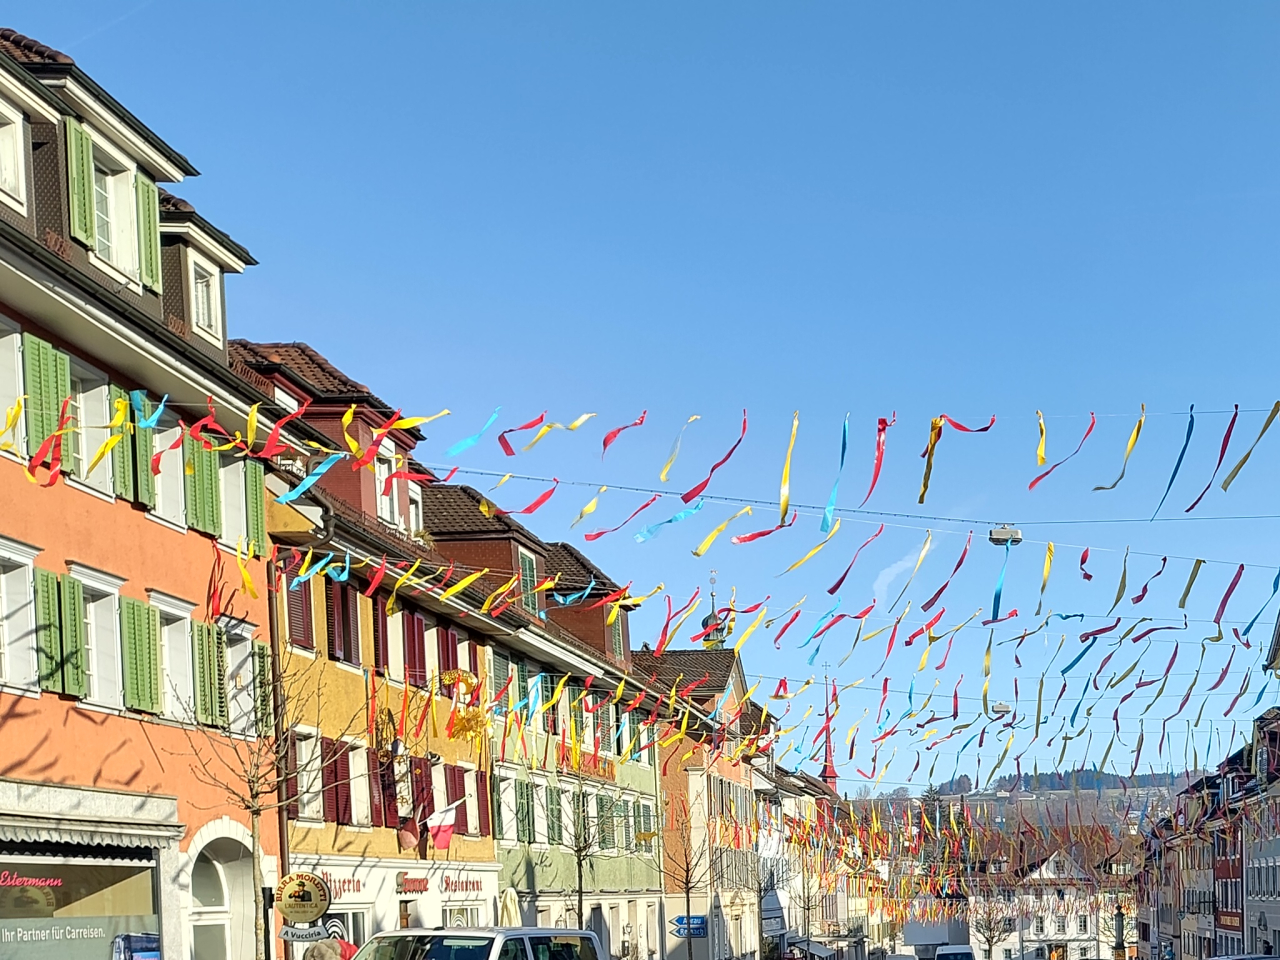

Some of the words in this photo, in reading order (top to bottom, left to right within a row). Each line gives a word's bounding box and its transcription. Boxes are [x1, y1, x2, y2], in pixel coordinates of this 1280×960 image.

[0, 871, 63, 887] Estermann
[276, 876, 295, 902] BIRRA
[1, 928, 15, 942] Ihr
[17, 926, 49, 941] Partner
[52, 926, 63, 940] für
[65, 925, 105, 939] Carreisen.
